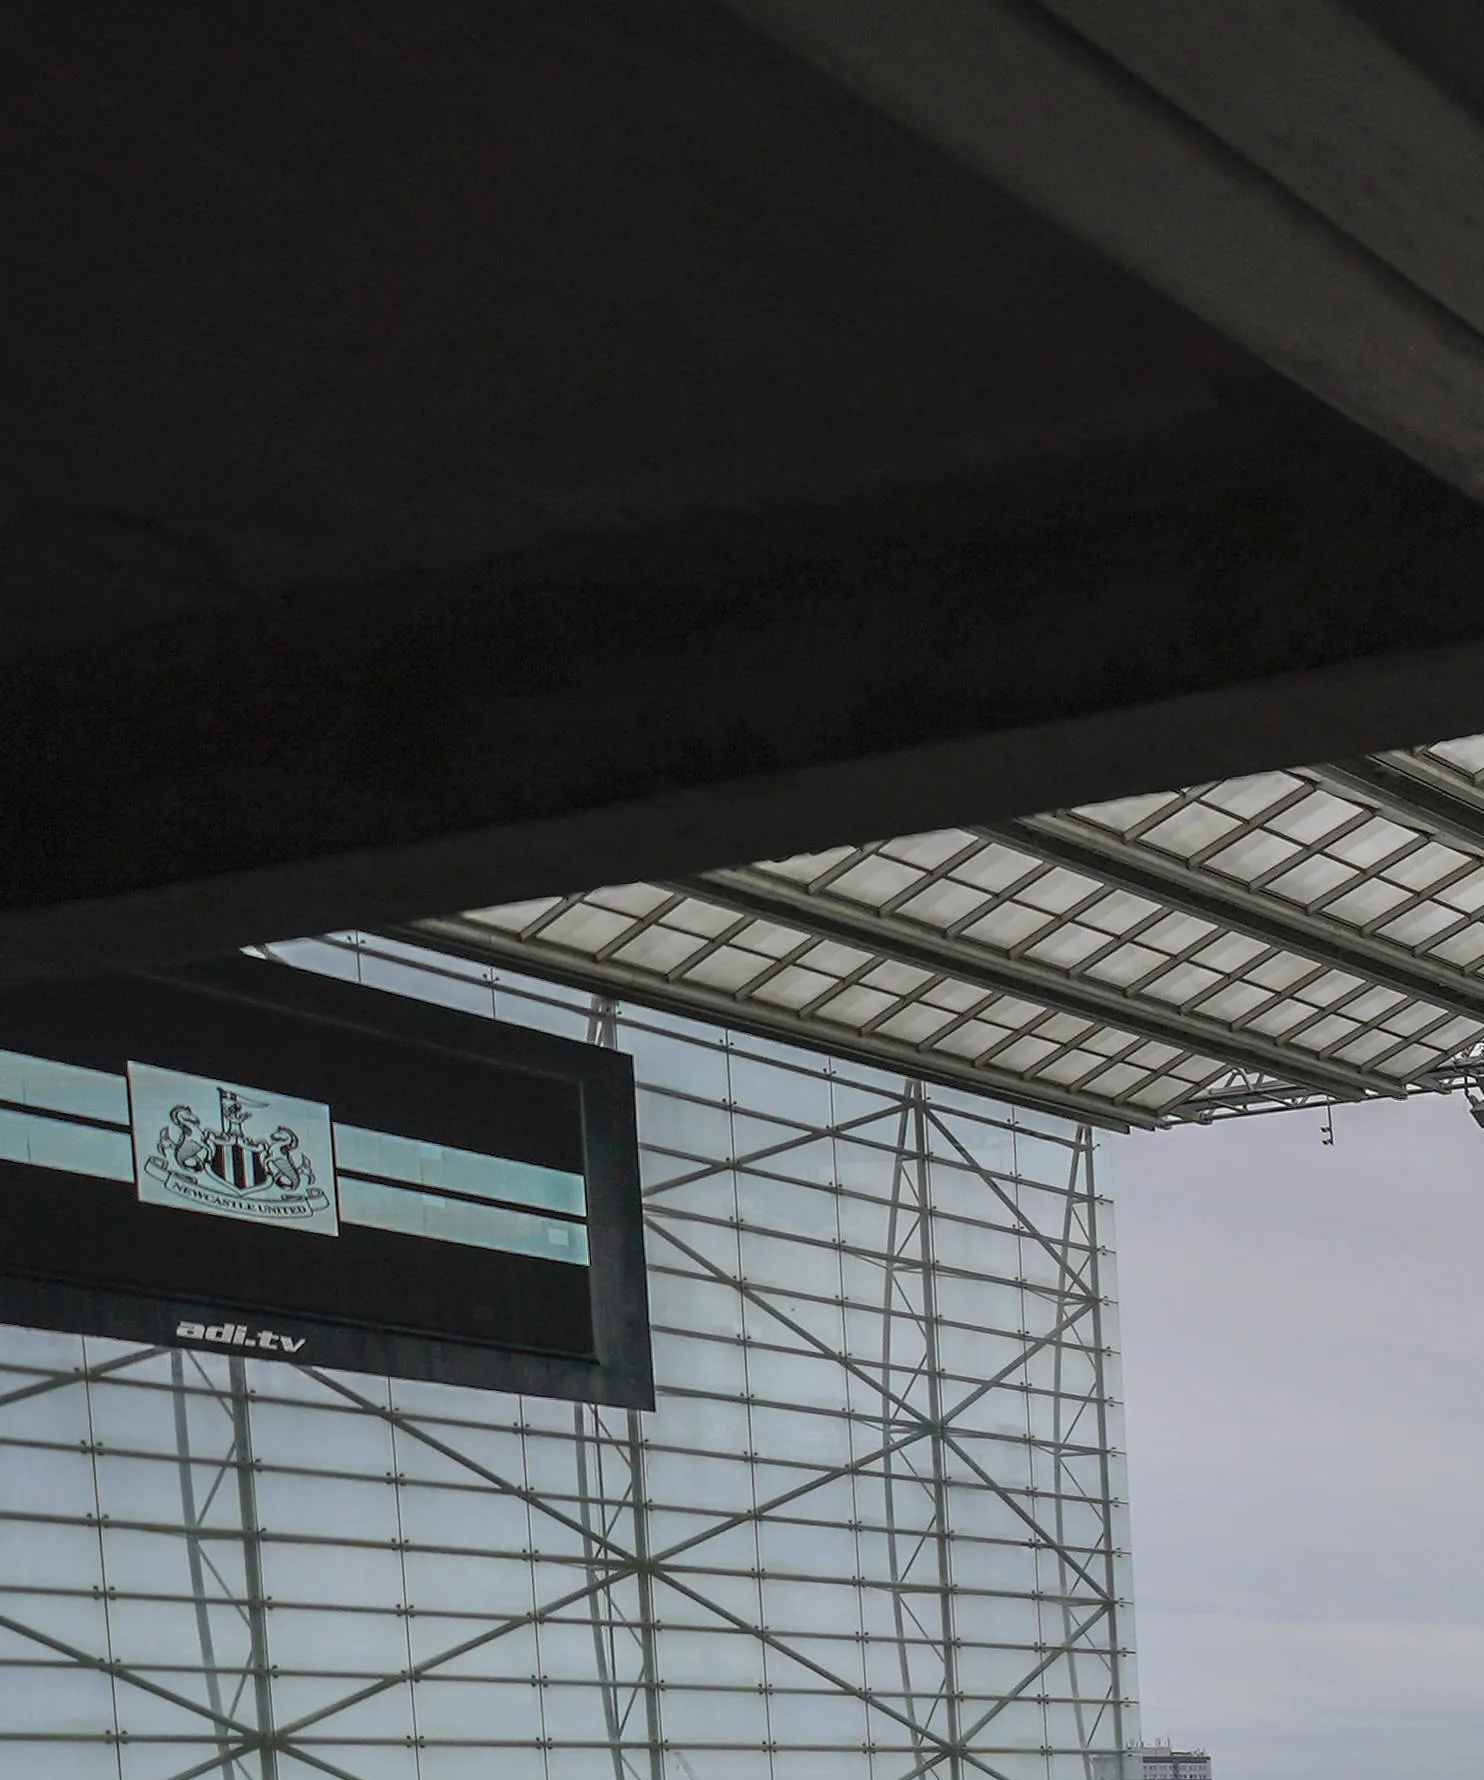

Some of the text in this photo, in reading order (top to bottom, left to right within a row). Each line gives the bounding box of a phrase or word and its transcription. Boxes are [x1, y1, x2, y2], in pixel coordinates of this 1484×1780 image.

[173, 1181, 308, 1215] NEWCASTLE UNITED
[176, 1320, 306, 1353] adi.tv
